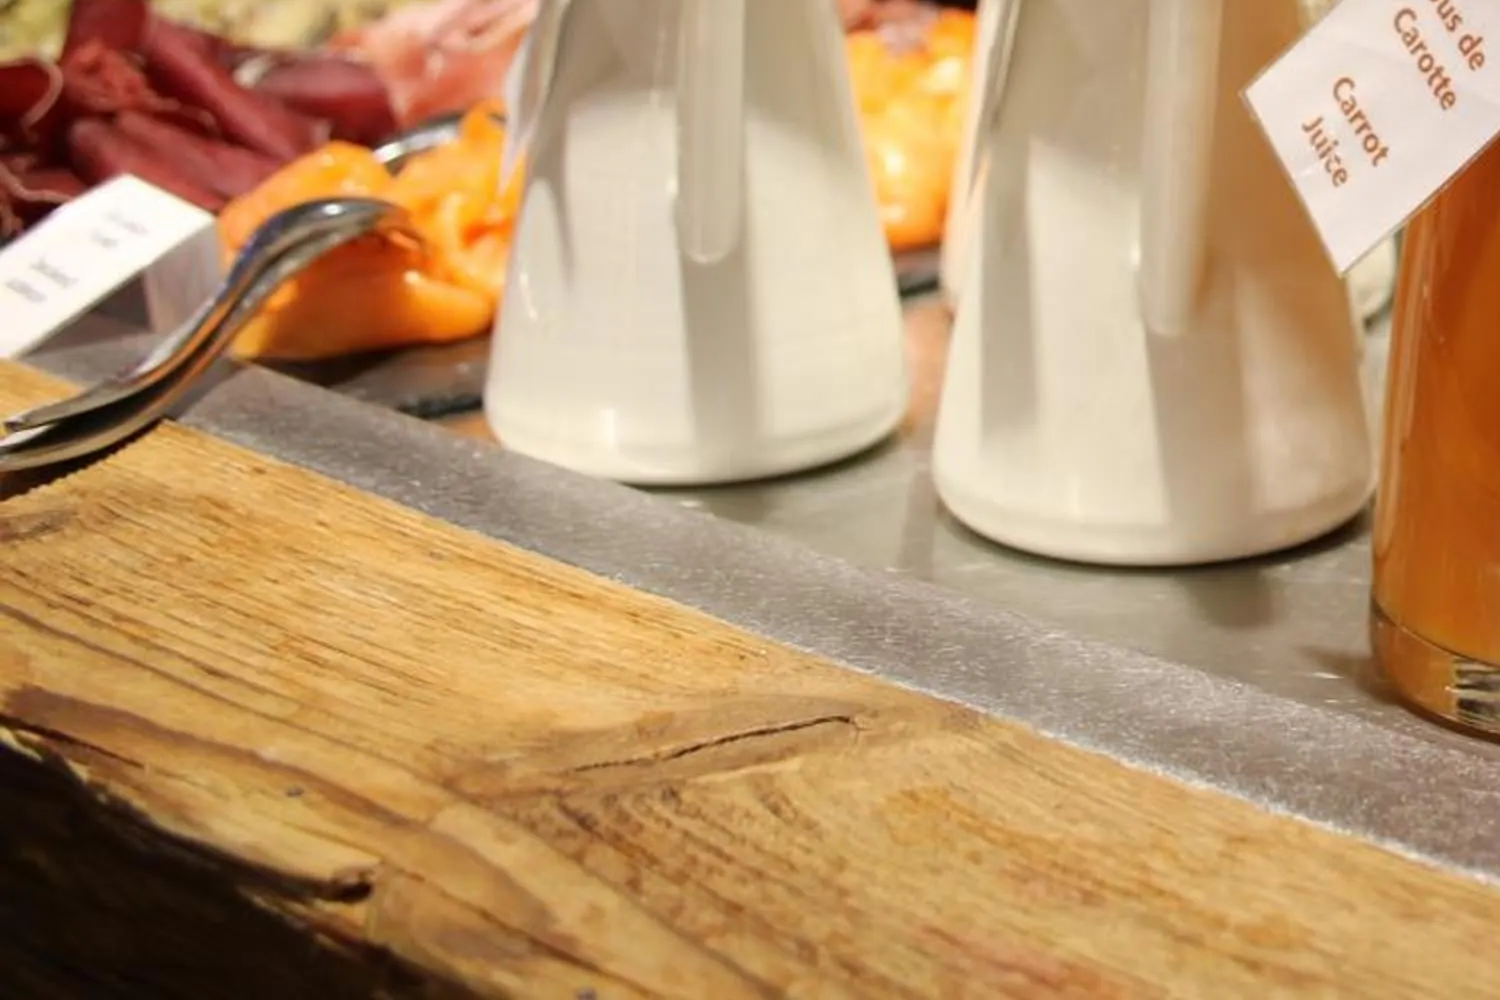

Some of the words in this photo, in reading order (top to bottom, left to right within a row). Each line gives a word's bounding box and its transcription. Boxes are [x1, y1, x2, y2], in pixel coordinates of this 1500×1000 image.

[1394, 7, 1456, 110] Carotte
[1458, 33, 1485, 71] de
[1301, 116, 1348, 187] Juice
[1333, 77, 1390, 167] Carrot
